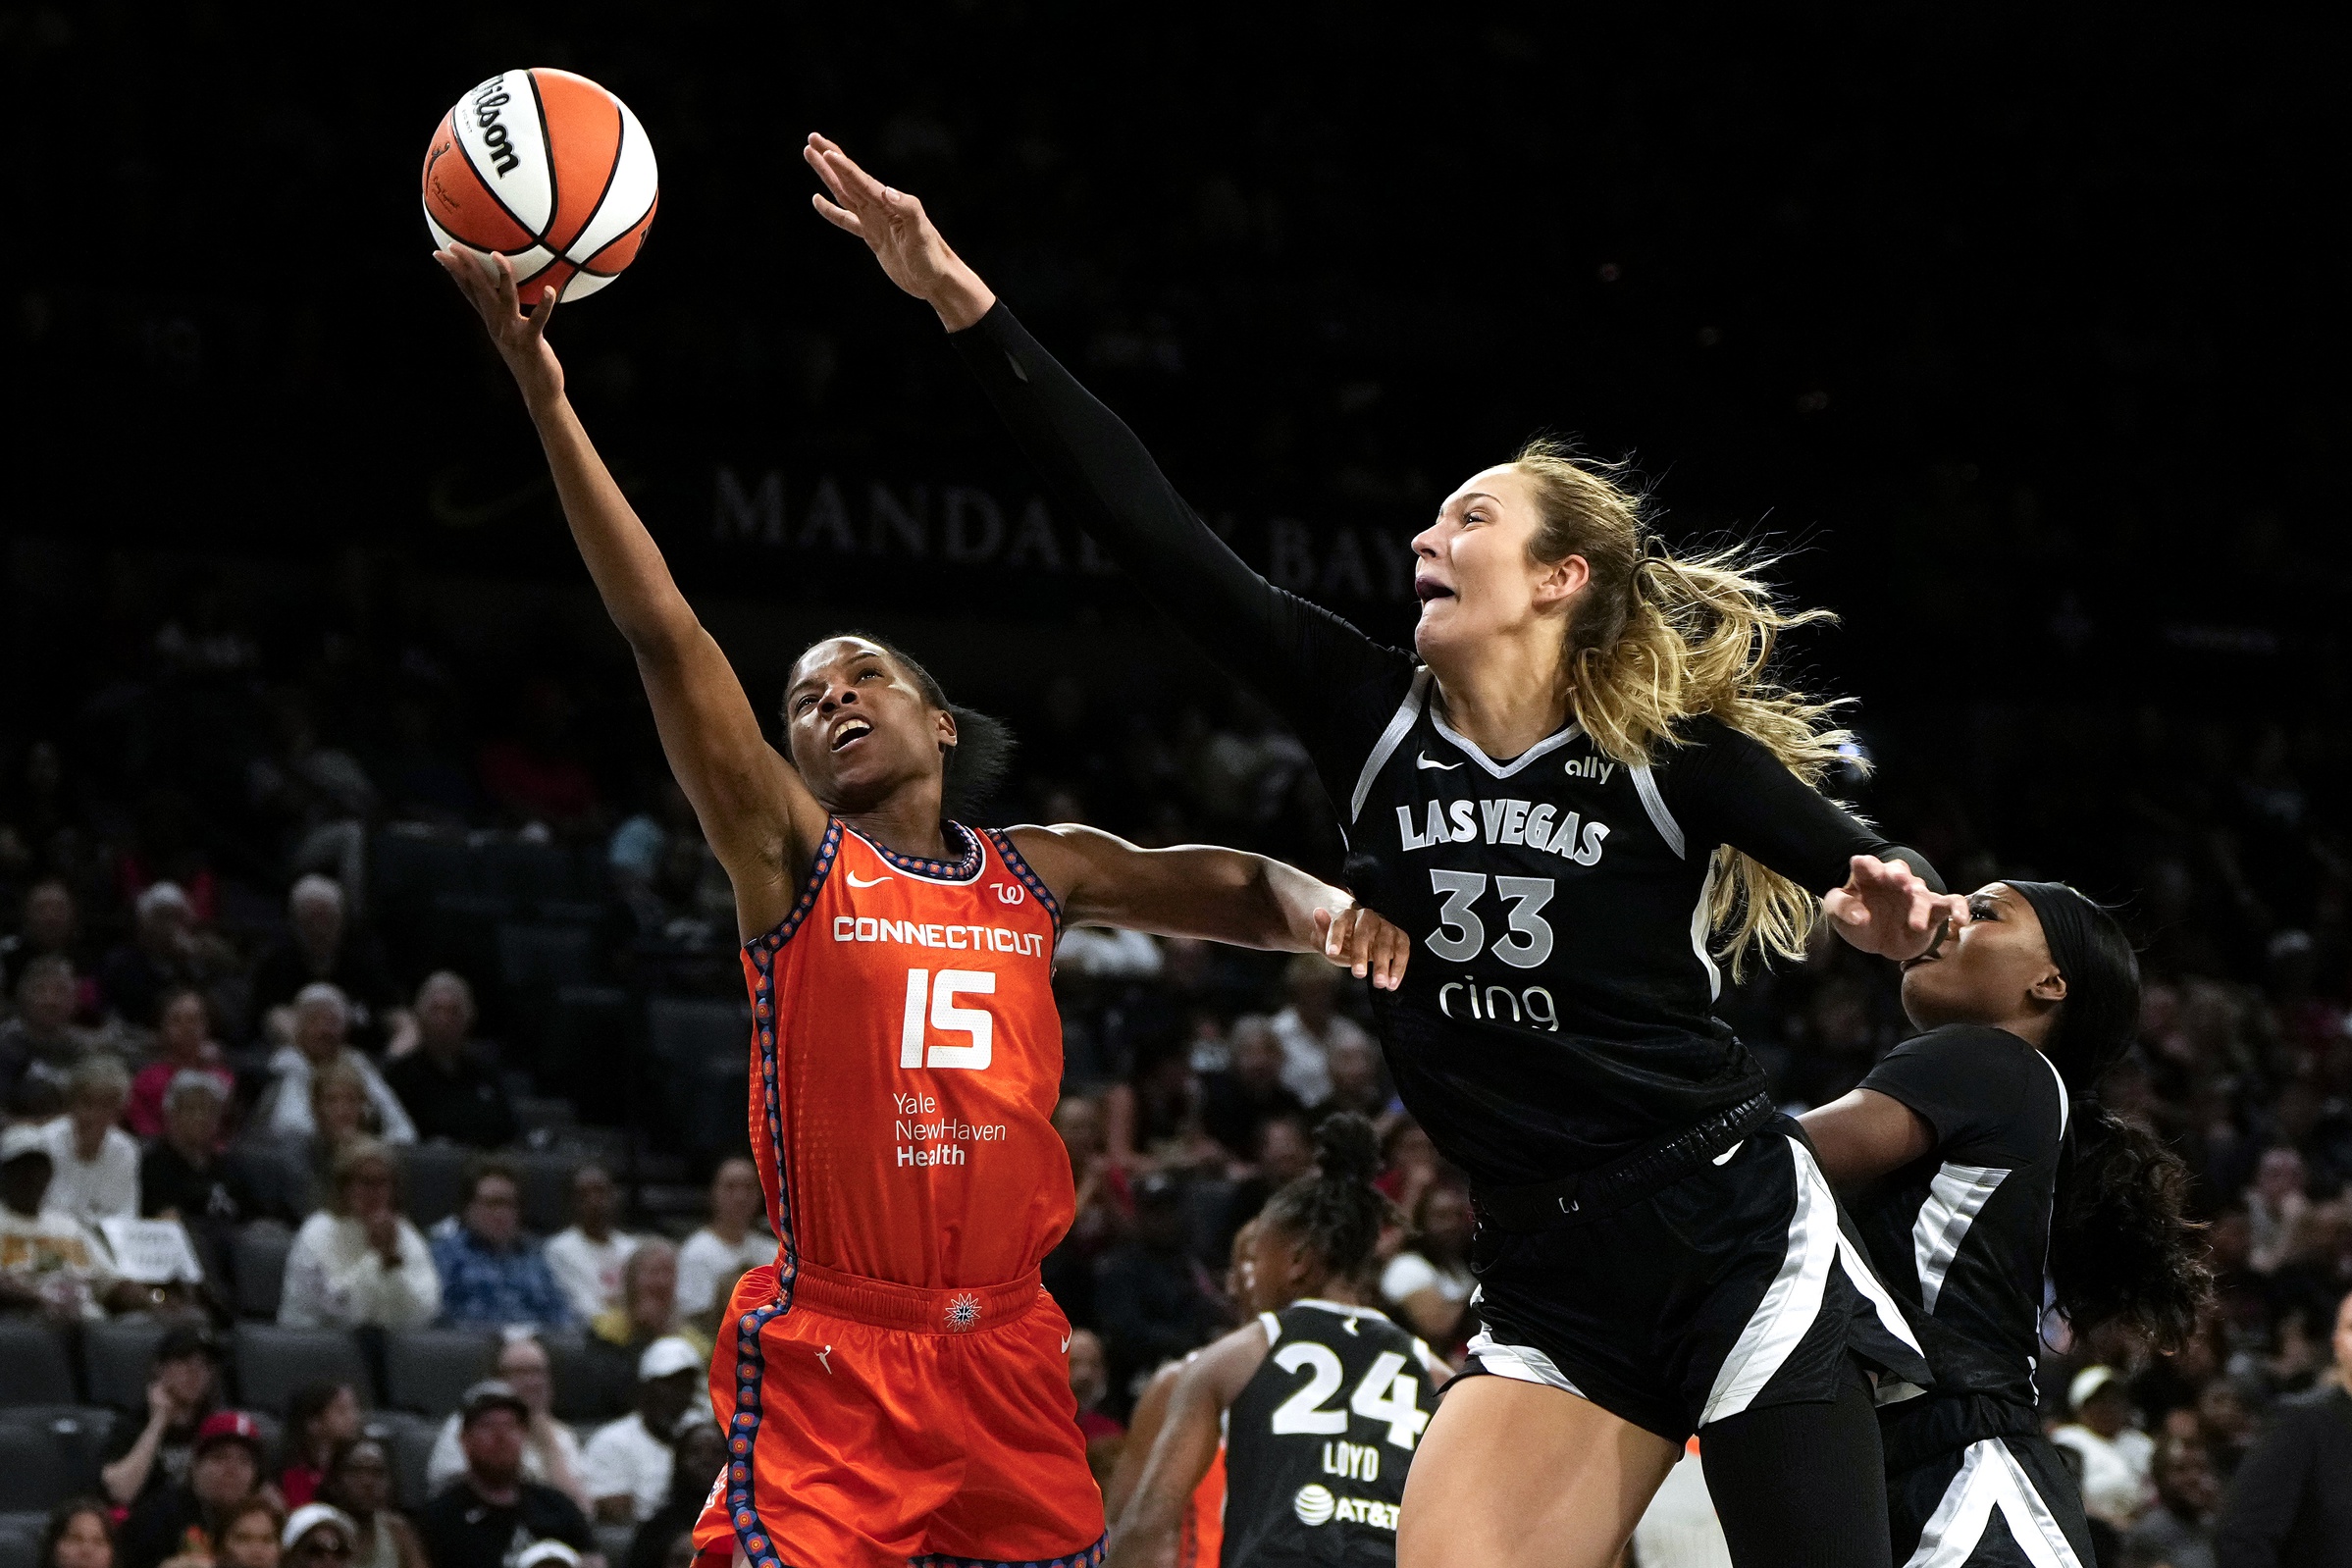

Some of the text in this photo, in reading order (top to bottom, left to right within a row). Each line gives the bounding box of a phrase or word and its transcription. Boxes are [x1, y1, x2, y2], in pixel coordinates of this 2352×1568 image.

[1564, 756, 1615, 785] ally
[1396, 799, 1611, 866] LAS VEGAS
[834, 915, 1043, 958] CONNECTICUT
[1425, 868, 1555, 968] 33
[900, 967, 996, 1071] 15
[1439, 975, 1560, 1032] ring
[893, 1092, 935, 1115] Yale
[897, 1143, 966, 1168] Health
[1273, 1340, 1431, 1450] 24
[1324, 1440, 1380, 1483] LOYD
